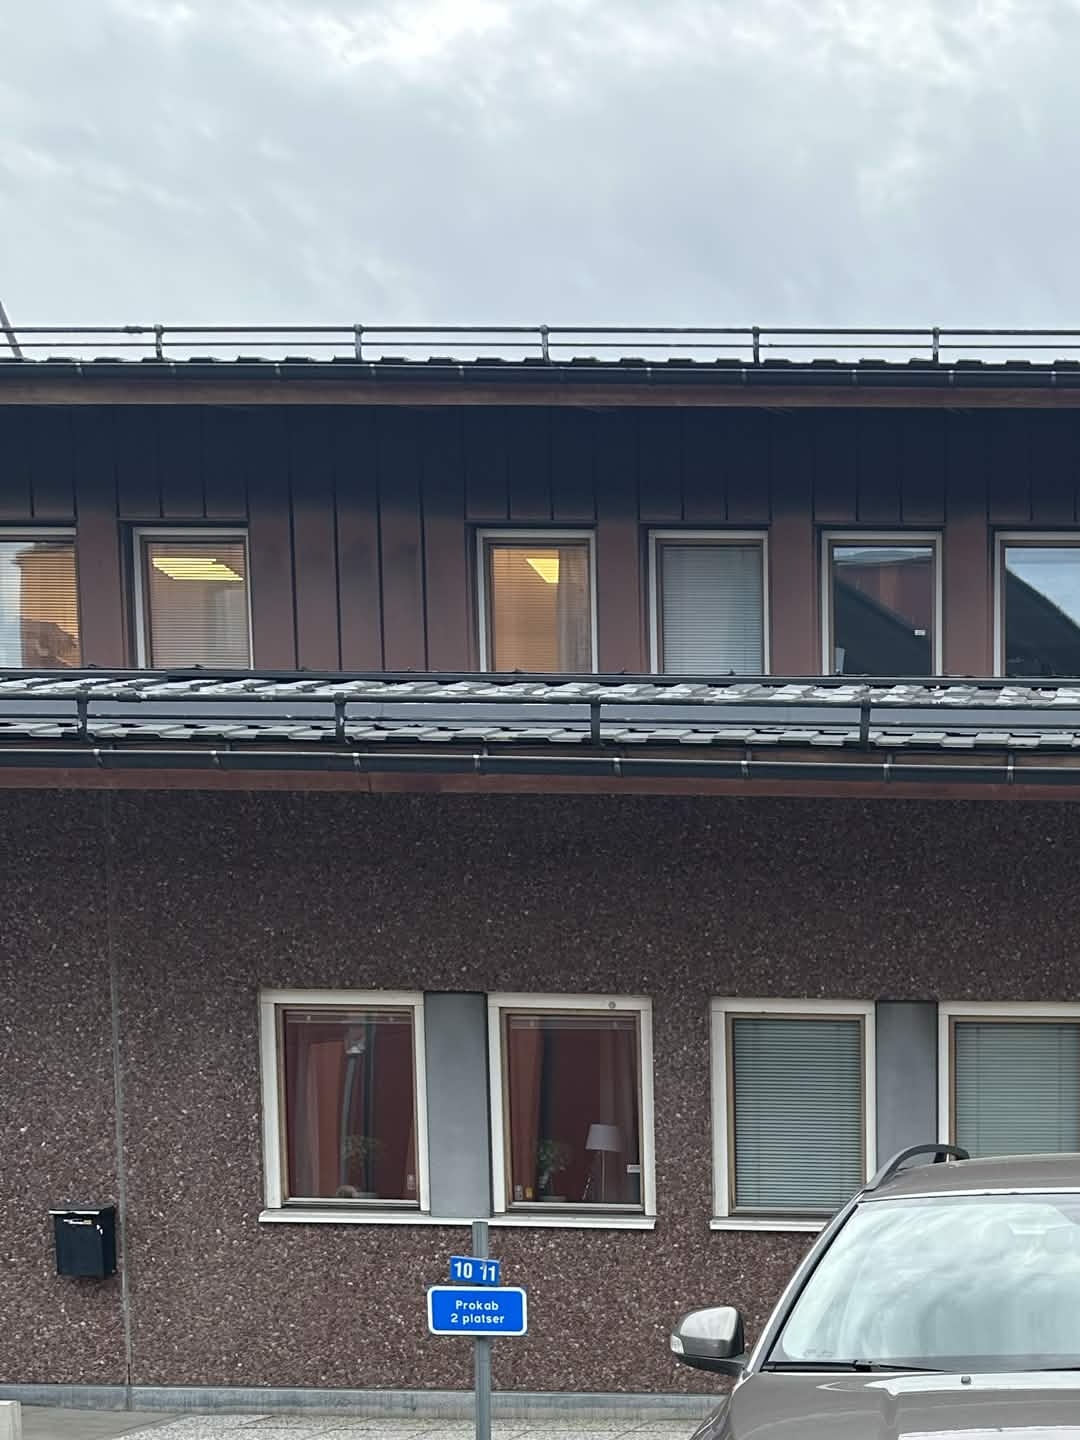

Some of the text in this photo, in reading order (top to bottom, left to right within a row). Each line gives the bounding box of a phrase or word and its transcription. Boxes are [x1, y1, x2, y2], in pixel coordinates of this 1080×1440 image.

[454, 1261, 473, 1278] 10
[455, 1300, 499, 1311] Prokab
[450, 1313, 505, 1326] 2 platser
